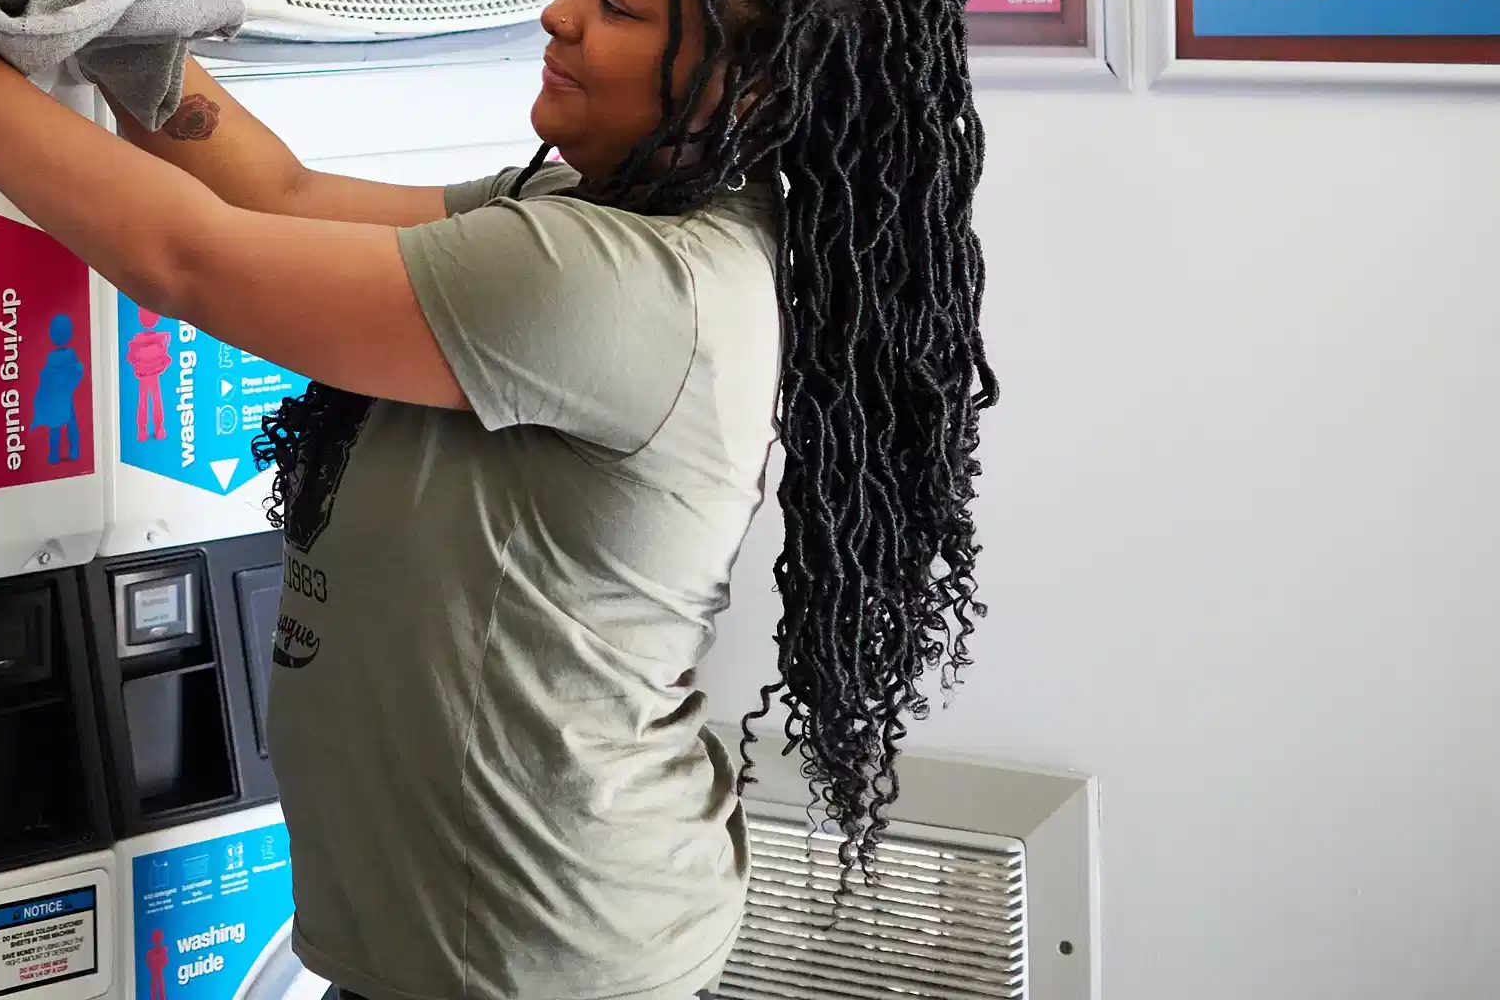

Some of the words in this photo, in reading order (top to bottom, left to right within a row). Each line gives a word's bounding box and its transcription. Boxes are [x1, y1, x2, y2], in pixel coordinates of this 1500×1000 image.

[176, 350, 197, 468] washing
[0, 389, 26, 471] guide
[23, 899, 63, 919] NOTICE
[10, 939, 31, 948] SHEETS
[11, 932, 23, 940] NOT
[23, 929, 35, 938] USE
[35, 924, 58, 935] COLOUR
[176, 922, 246, 954] washing
[2, 951, 15, 960] SAVE
[16, 947, 36, 957] MONEY
[177, 952, 225, 985] guide
